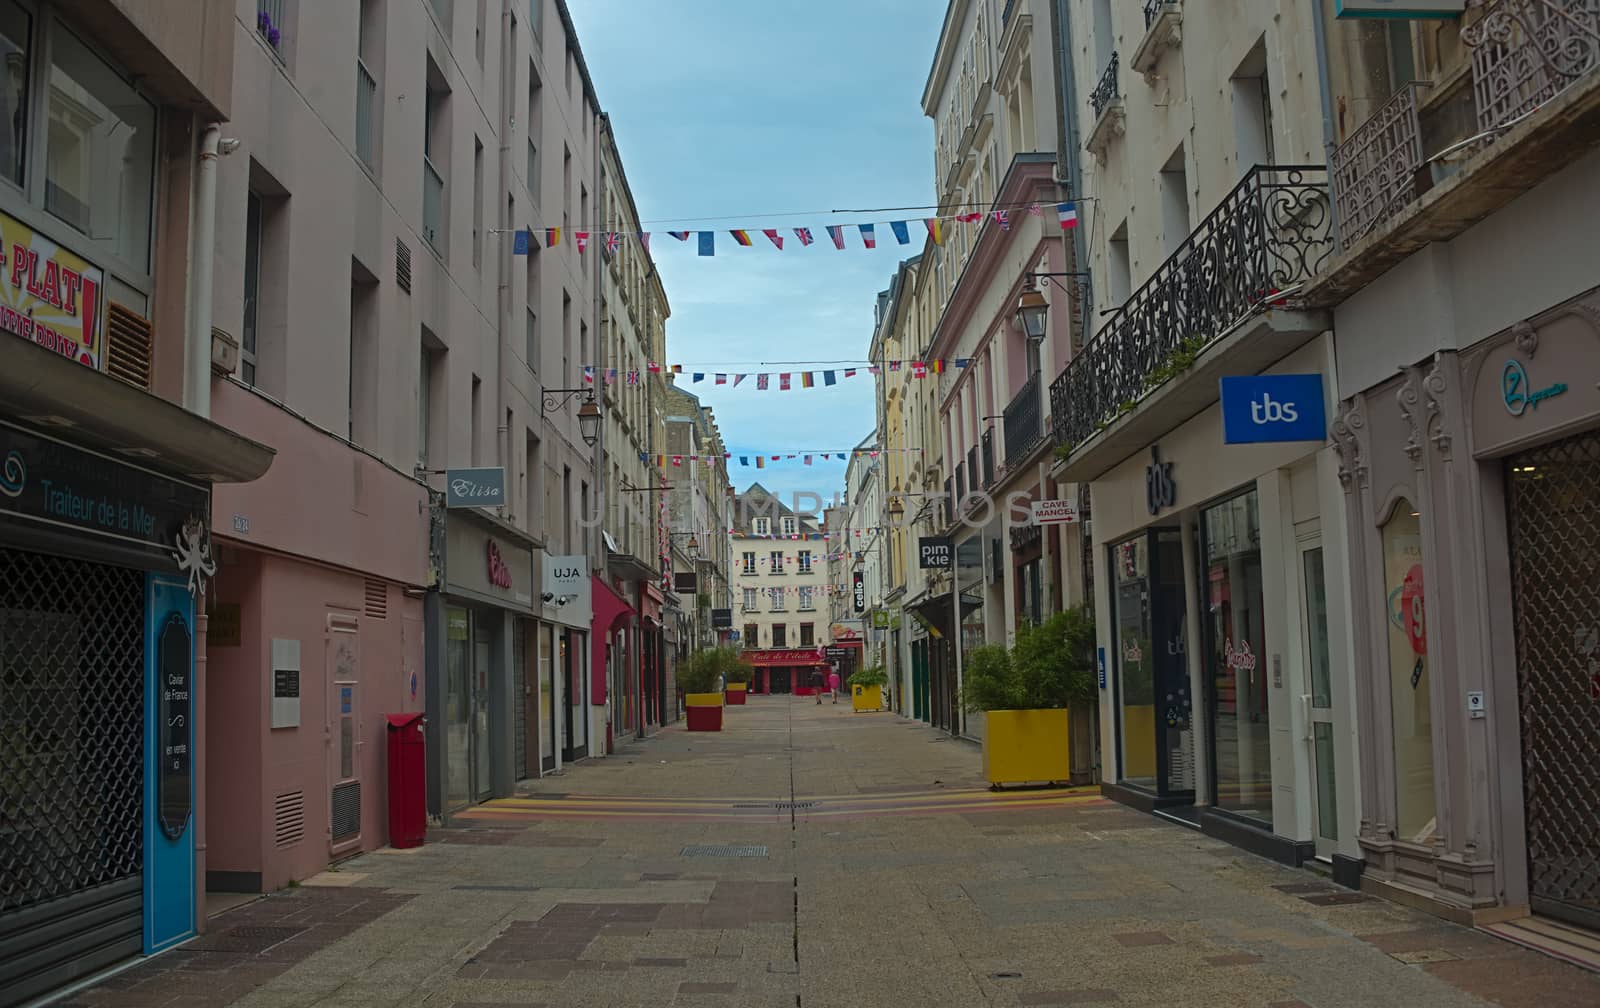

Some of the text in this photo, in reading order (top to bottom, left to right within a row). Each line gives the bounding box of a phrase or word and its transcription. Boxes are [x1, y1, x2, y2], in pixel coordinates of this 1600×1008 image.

[1250, 392, 1298, 425] tbs
[451, 477, 501, 499] Elisa
[1145, 444, 1176, 515] tbs
[40, 478, 157, 537] Traiteur de la Mer
[1035, 508, 1076, 517] MANCEL
[1042, 500, 1068, 509] CAVE
[554, 568, 580, 578] UJA
